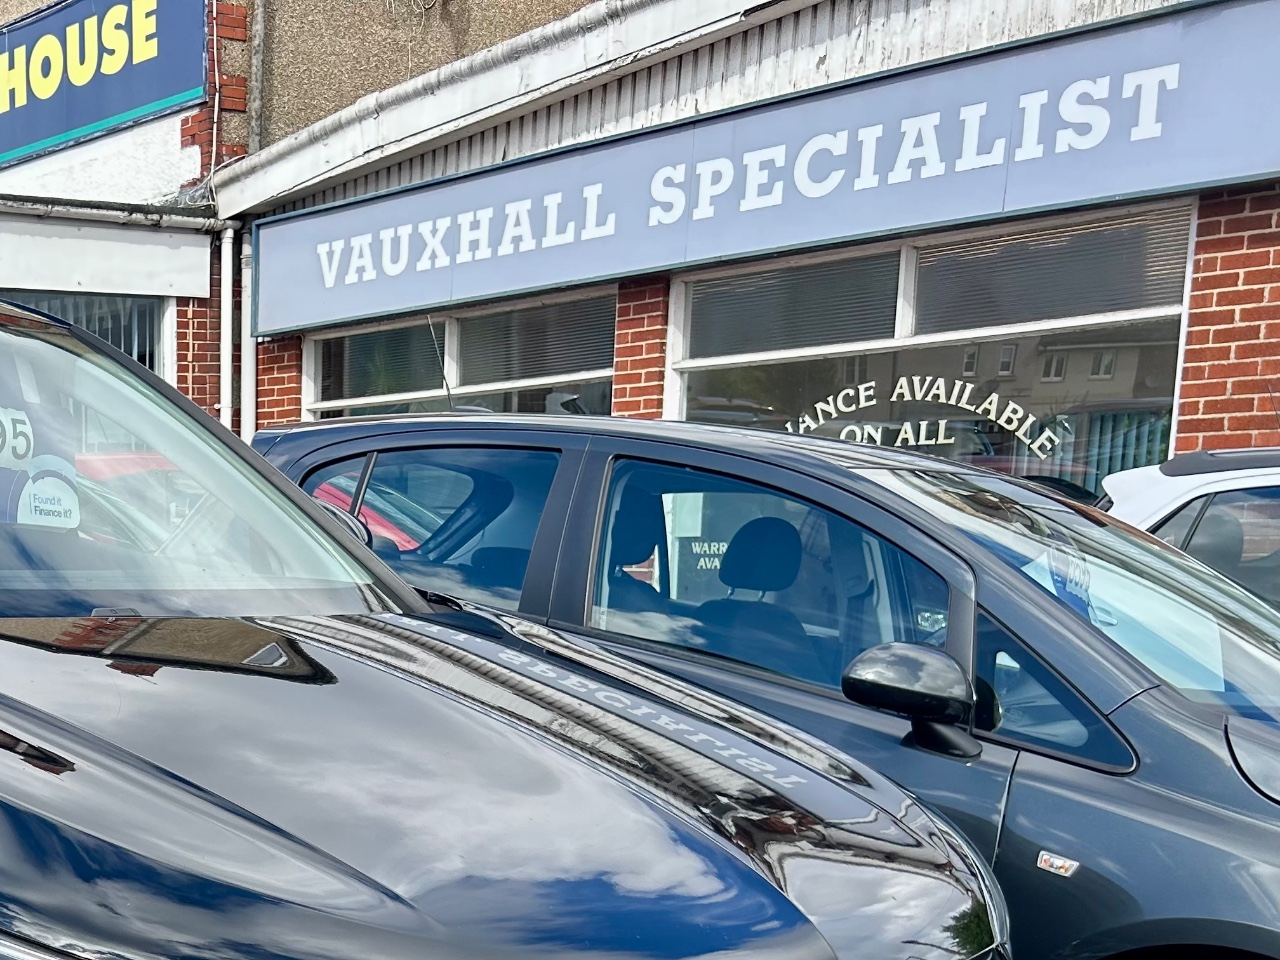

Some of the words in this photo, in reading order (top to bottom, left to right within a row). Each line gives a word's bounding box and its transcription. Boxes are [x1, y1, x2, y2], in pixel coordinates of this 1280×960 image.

[317, 183, 616, 288] VAUXHALL
[648, 63, 1180, 227] SPECIALIST
[785, 381, 877, 434] ANCE
[890, 375, 1060, 460] AVAILABLE
[839, 425, 882, 446] ON
[894, 420, 955, 447] ALL
[34, 505, 63, 518] Finance
[691, 541, 728, 556] WARR
[696, 557, 721, 571] AVA
